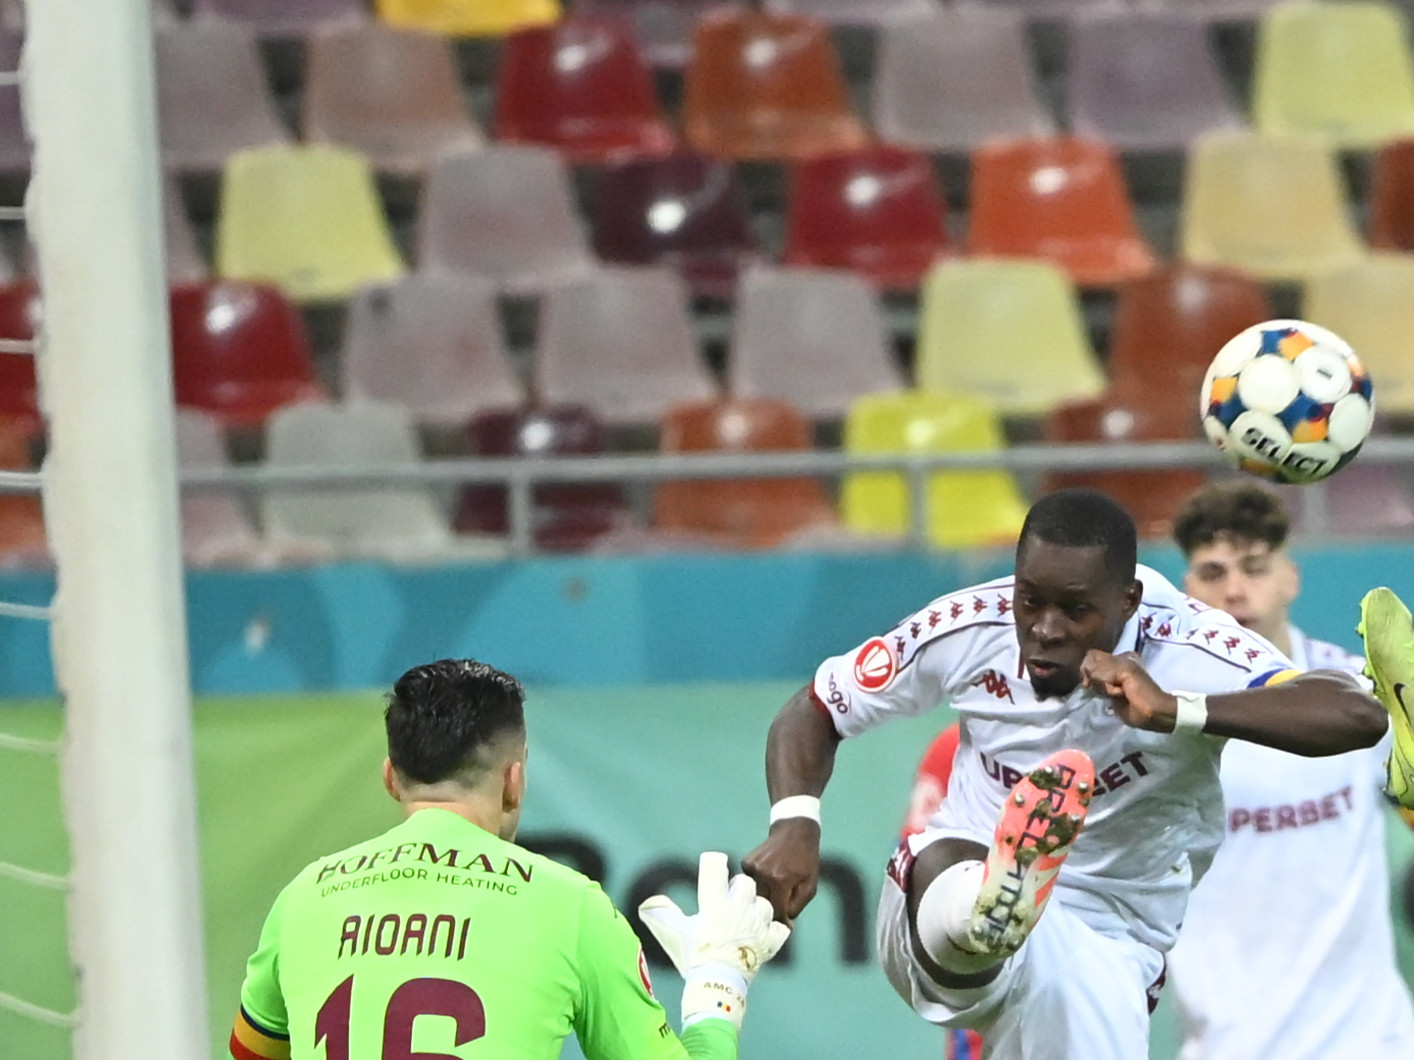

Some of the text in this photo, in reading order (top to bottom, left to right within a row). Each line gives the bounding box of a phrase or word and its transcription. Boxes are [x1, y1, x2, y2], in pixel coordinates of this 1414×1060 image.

[1241, 427, 1328, 475] SELECT
[315, 842, 534, 885] HOFFMAN
[321, 867, 518, 898] UNDERFLOOR HEATING
[337, 913, 471, 961] AIOANI
